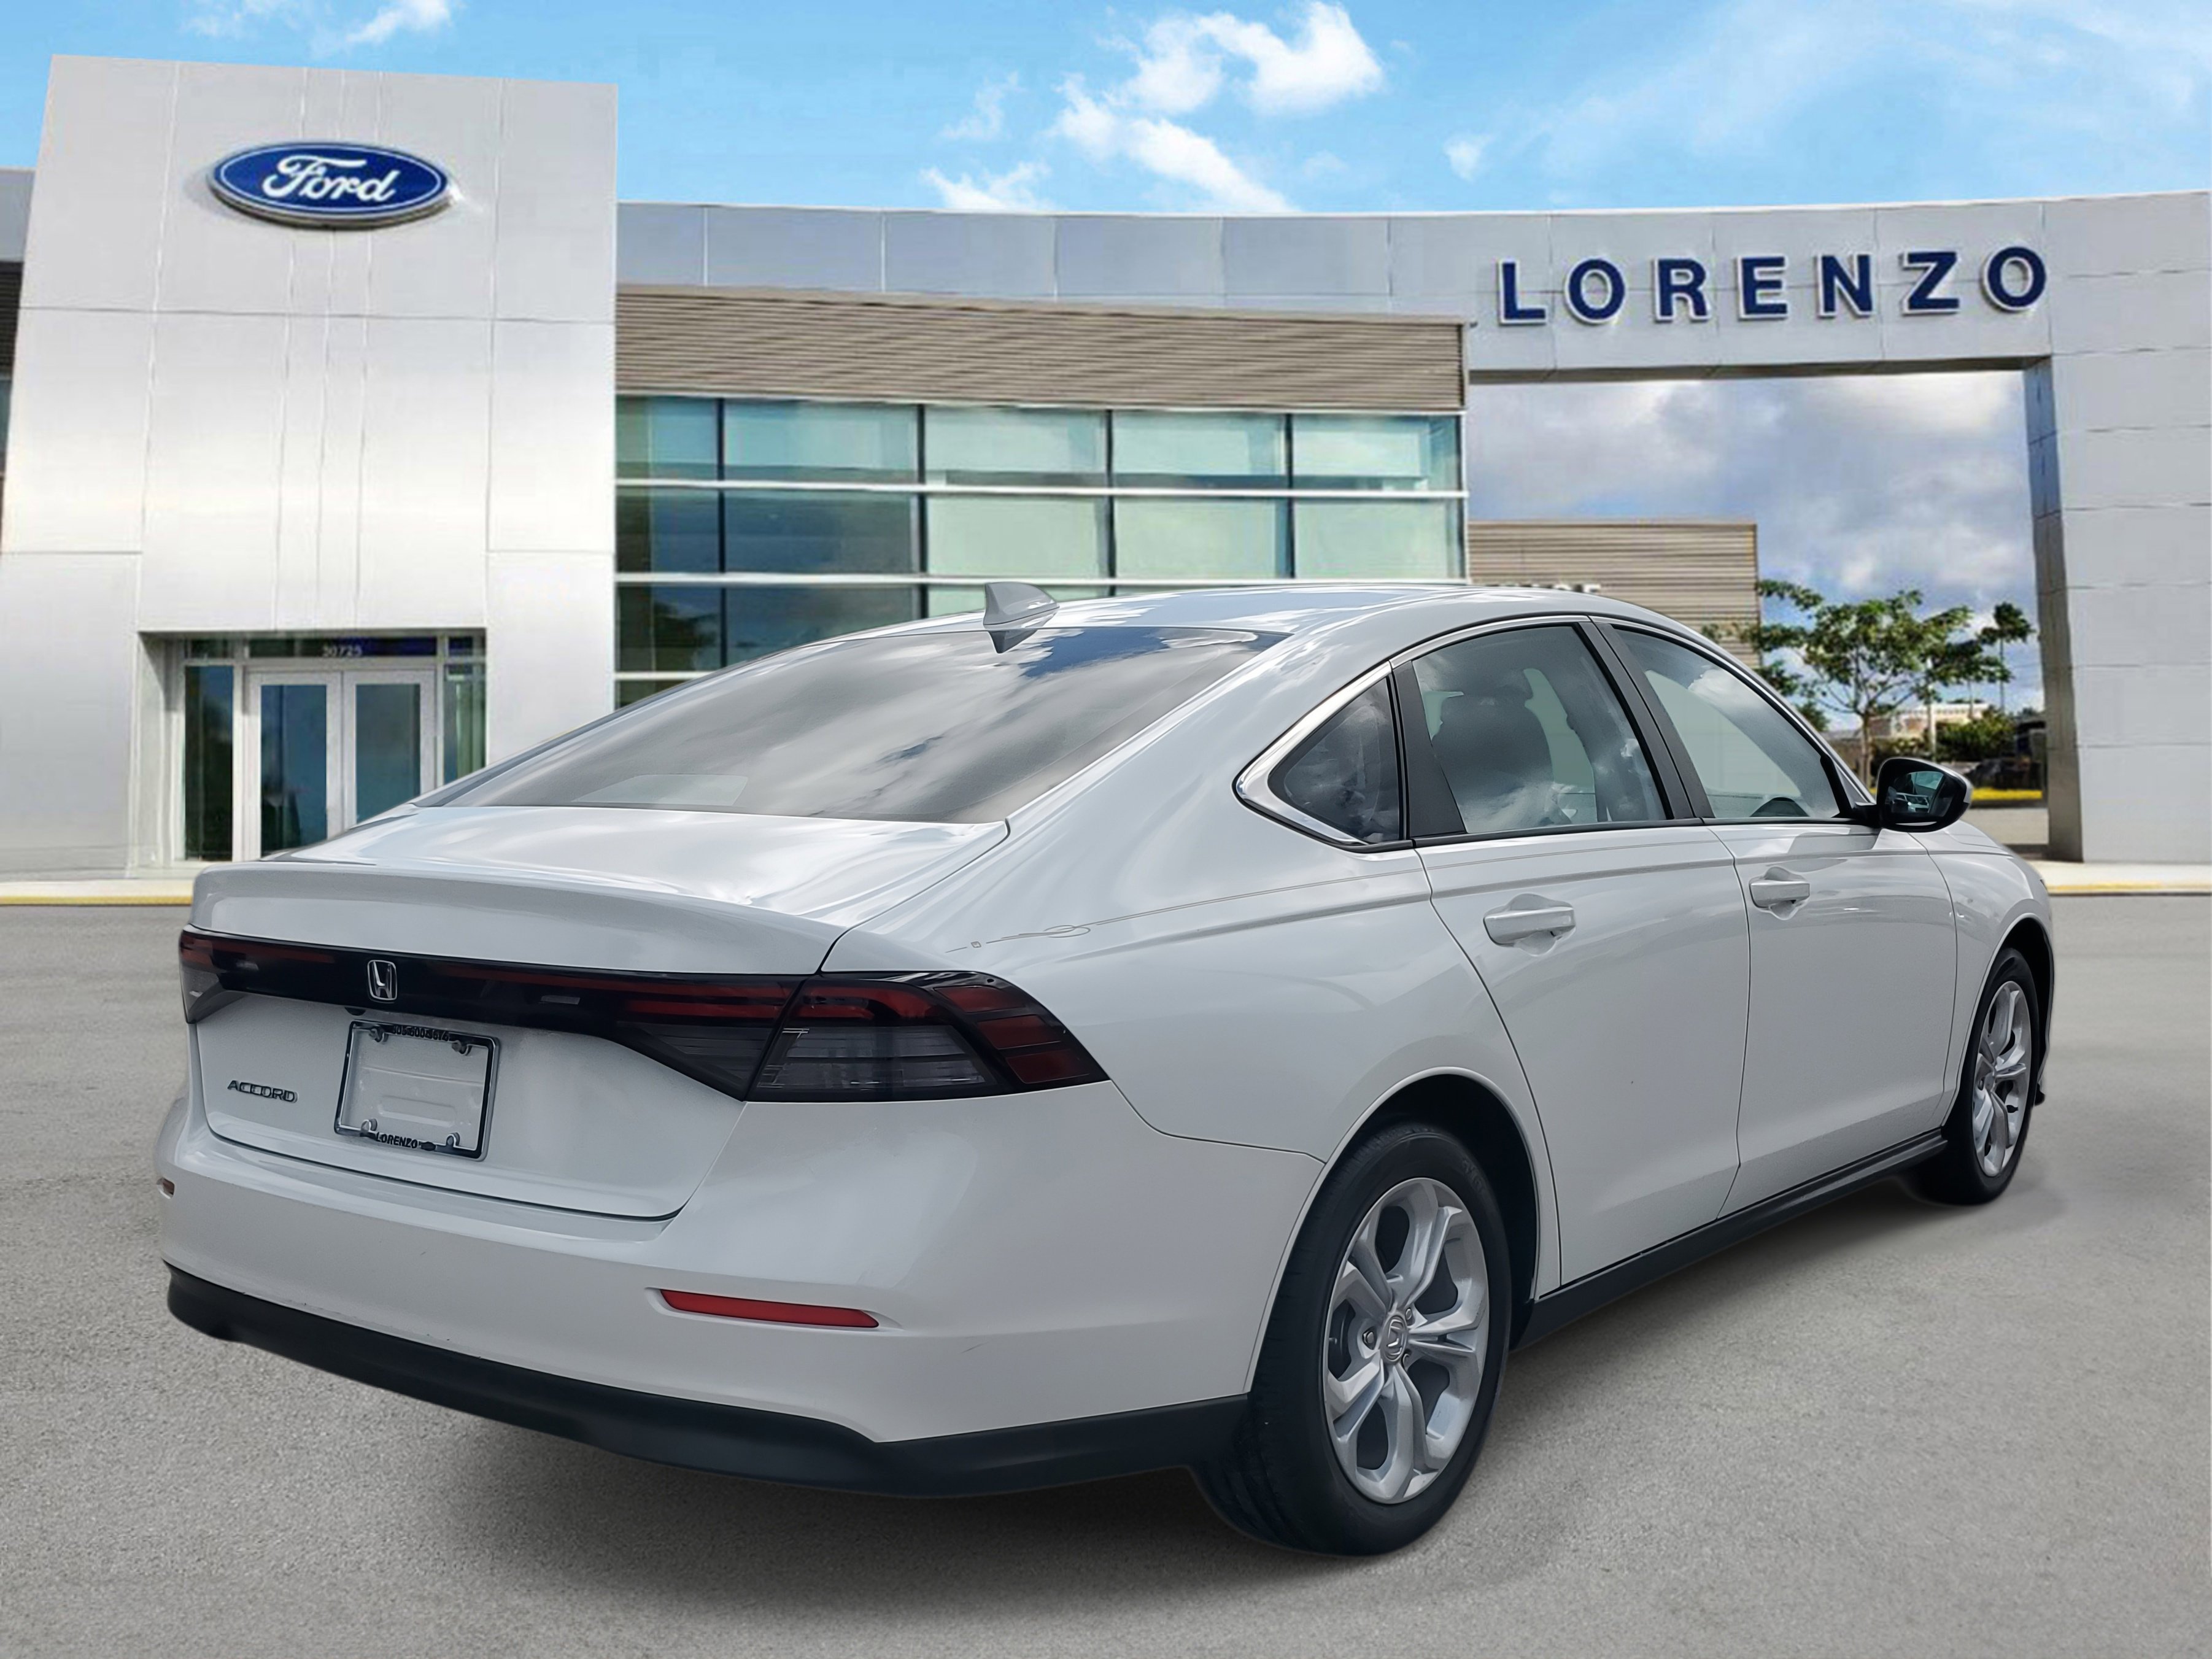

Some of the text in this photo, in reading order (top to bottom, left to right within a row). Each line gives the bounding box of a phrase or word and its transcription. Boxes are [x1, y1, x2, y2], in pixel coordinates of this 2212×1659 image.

[262, 154, 400, 201] Ford
[1498, 246, 2047, 325] LORENZO
[227, 1080, 298, 1104] ACCORD
[376, 1132, 418, 1149] LORENZO
